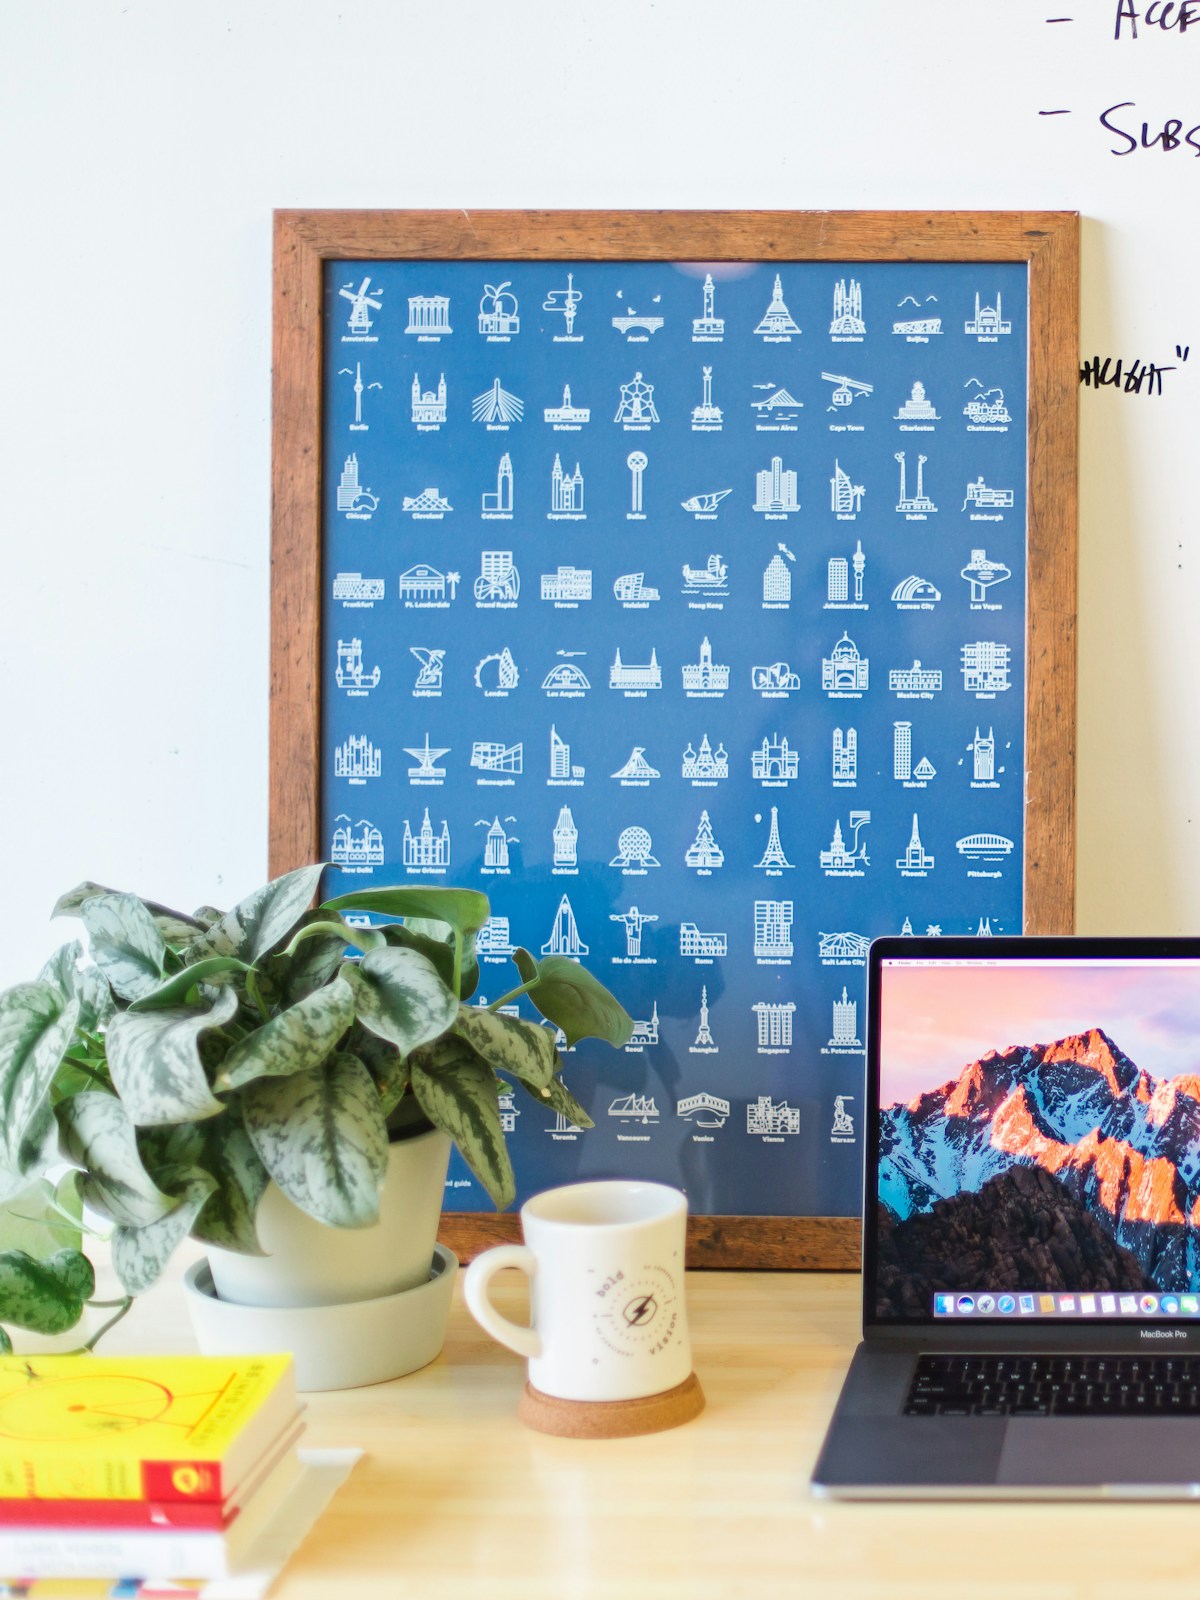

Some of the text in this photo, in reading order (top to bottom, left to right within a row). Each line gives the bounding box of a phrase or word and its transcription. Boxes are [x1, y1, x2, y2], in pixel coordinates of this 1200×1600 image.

[340, 335, 379, 343] Amsterdam
[417, 335, 441, 343] Athens
[486, 335, 511, 343] Atlanta
[552, 335, 585, 343] Auckland
[626, 335, 650, 343] Austin
[691, 335, 724, 343] Baltimore
[762, 335, 793, 343] Bangkok
[831, 335, 865, 343] Barcelona
[905, 335, 930, 344] Beijing
[977, 335, 999, 343] Beirut
[349, 423, 370, 432] Berlin
[485, 423, 510, 432] Boston
[552, 423, 583, 432] Brisbane
[623, 423, 652, 432] Brussels
[691, 424, 723, 432] Budapest
[755, 424, 799, 432] Buenos Aires
[899, 424, 936, 432] Charleston
[345, 512, 373, 521] Chicago
[411, 512, 445, 520] Cleveland
[481, 512, 514, 521] Columbus
[546, 512, 588, 521] Copenhagen
[626, 512, 647, 521] Dallas
[694, 513, 719, 521] Denver
[764, 513, 789, 521] Detroit
[836, 513, 857, 521] Dubai
[905, 513, 928, 521] Dublin
[969, 513, 1004, 522] Edinburgh
[342, 600, 374, 609] Frankfurt
[415, 601, 451, 609] Lauderdale
[475, 601, 519, 609] Grand Rapids
[553, 601, 579, 609] Havana
[622, 601, 650, 609] Helsinki
[761, 602, 790, 610] Houston
[822, 602, 870, 610] Johannesburg
[982, 603, 1003, 611] Vegas
[346, 689, 369, 697] Lisbon
[411, 689, 443, 698] Ljubljana
[484, 690, 509, 698] London
[560, 690, 586, 698] Angeles
[623, 690, 648, 698] Madrid
[686, 691, 725, 699] Manchester
[827, 691, 863, 699] Melbourne
[896, 691, 921, 699] Mexico
[975, 692, 996, 700] Miami
[348, 777, 367, 786] Milan
[409, 777, 445, 786] Milwaukee
[476, 778, 516, 787] Minneapolis
[546, 779, 585, 787] Montevideo
[620, 779, 650, 787] Montreal
[761, 779, 789, 788] Mumbai
[832, 780, 858, 788] Munich
[902, 780, 928, 789] Nairobi
[969, 781, 1001, 789] Nashville
[357, 865, 374, 875] Delhi
[422, 866, 447, 876] Orleans
[551, 867, 580, 876] Oakland
[621, 868, 649, 876] Orlando
[765, 869, 784, 877] Paris
[824, 869, 866, 877] Philadelphia
[900, 869, 928, 878] Phoenix
[966, 870, 1003, 878] Pittsburgh
[483, 956, 508, 965] Prague
[632, 957, 658, 965] Janeiro
[756, 958, 792, 966] Rotterdam
[624, 1045, 644, 1053] Seoul
[687, 1046, 719, 1054] Shanghai
[756, 1047, 791, 1055] Singapore
[831, 1047, 868, 1055] Petersburg
[551, 1133, 578, 1141] Toronto
[692, 1135, 715, 1143] Venice
[761, 1135, 786, 1143] Vienna
[830, 1136, 857, 1144] Warsaw
[596, 1270, 625, 1298] bold
[1139, 1329, 1188, 1339] MacBook Pro
